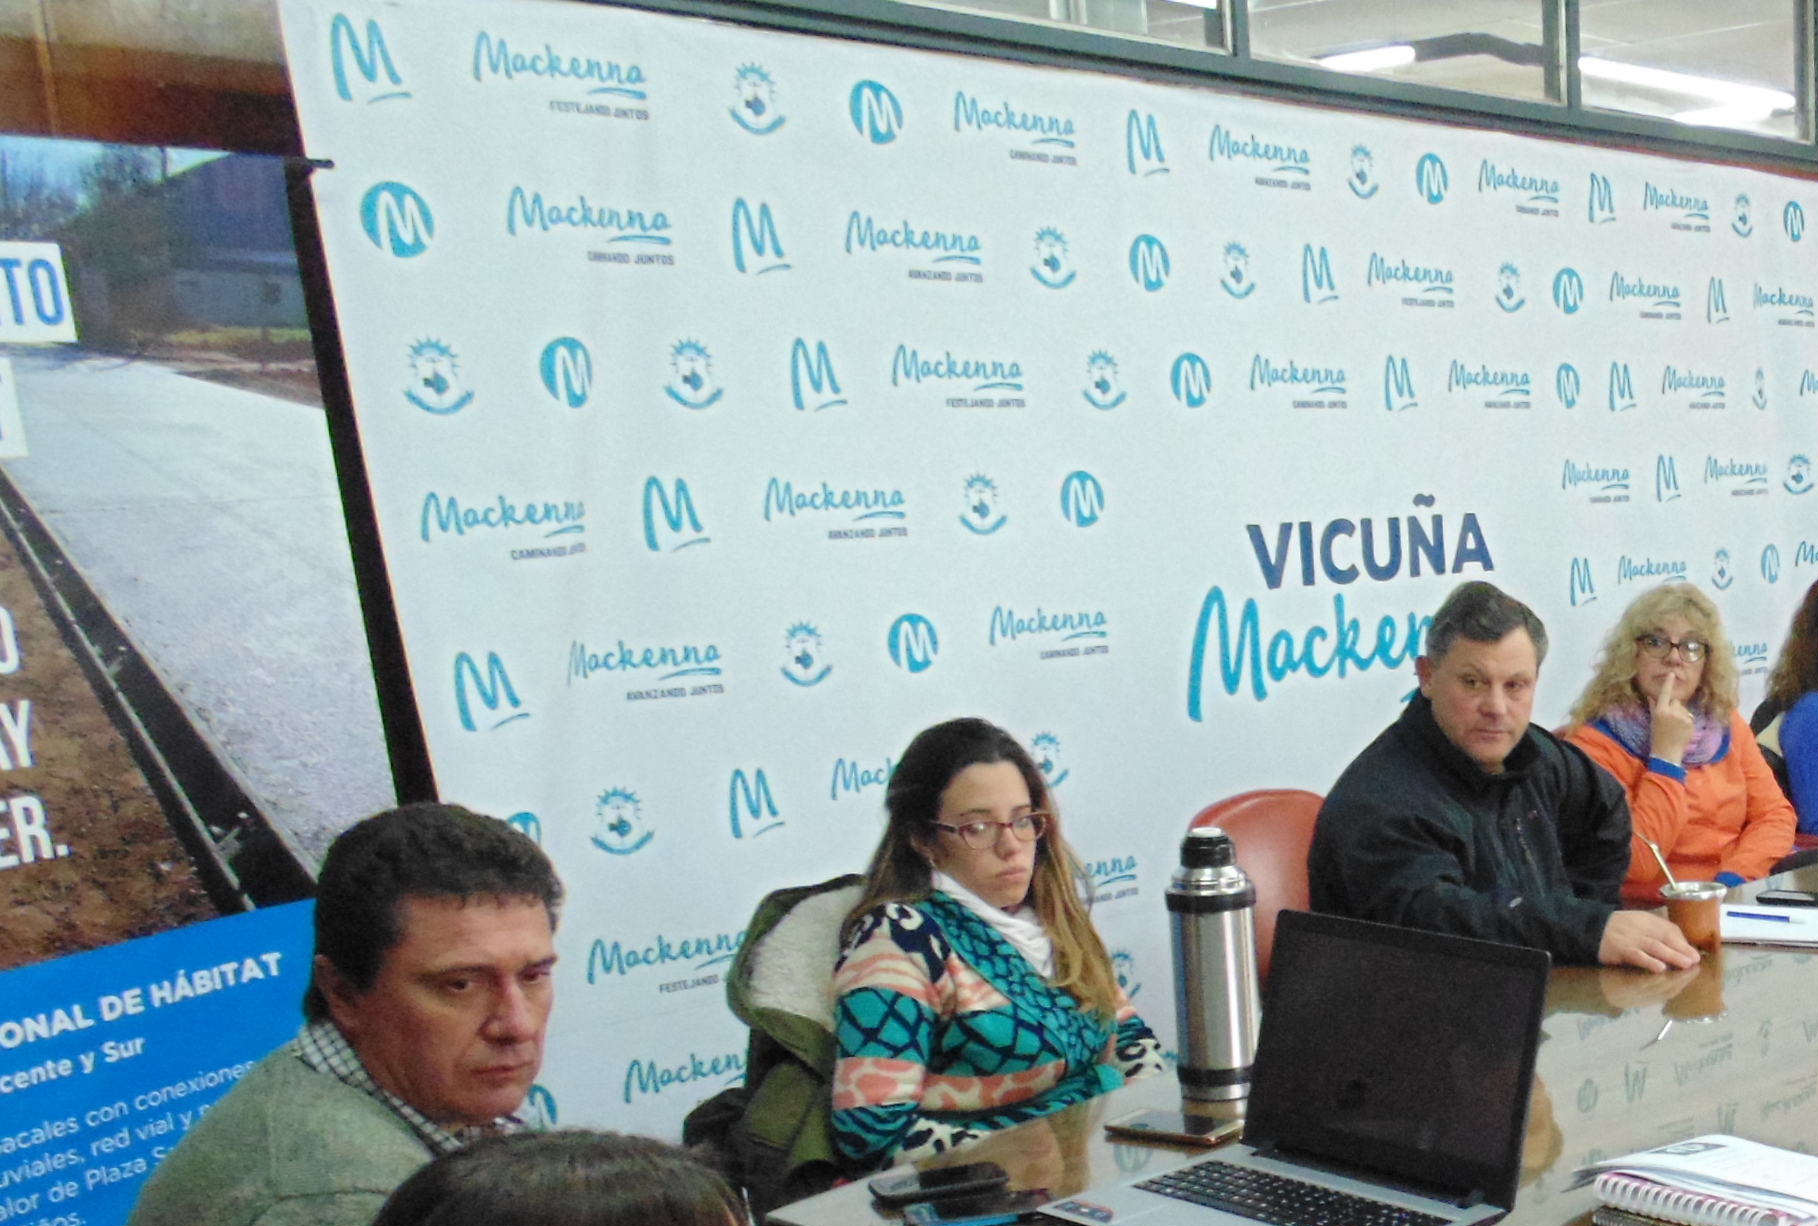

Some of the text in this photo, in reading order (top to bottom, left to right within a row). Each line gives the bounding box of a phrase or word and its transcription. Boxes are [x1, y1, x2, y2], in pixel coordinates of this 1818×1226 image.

[473, 32, 647, 86] Mackenna
[954, 91, 1075, 136] Mackenna
[1208, 124, 1309, 167] Mackenna
[1479, 159, 1559, 194] Mackenna
[1644, 181, 1709, 212] Mackenna
[507, 186, 671, 237] Mackenna
[845, 211, 982, 253] Mackenna
[634, 253, 674, 267] JUNTOS
[1367, 252, 1453, 288] Mackenna
[1609, 271, 1680, 302] Mackenna
[892, 345, 1023, 387] Mackenna
[1250, 354, 1345, 392] Mackenna
[1449, 359, 1530, 393] Mackenna
[1662, 365, 1725, 395] Mackenna
[1563, 458, 1630, 490] Mackenna
[1704, 456, 1767, 484] Mackenna
[764, 478, 905, 521] Mackenna
[1246, 493, 1494, 589] VICUÑA
[1618, 555, 1687, 584] Mackenna
[989, 606, 1107, 645] Mackenna
[567, 640, 722, 687] Mackenna
[1187, 585, 1433, 722] Macken
[626, 684, 725, 702] AVANZANDO JUNTOS
[830, 757, 896, 800] Mack
[0, 952, 283, 1048] ONAL DE HÁBITAT
[659, 974, 719, 994] FESTEJANDO
[0, 1037, 145, 1093] cente y Sur
[624, 1050, 746, 1104] Macken
[0, 1117, 79, 1154] acales
[85, 1101, 129, 1127] con
[90, 1128, 131, 1156] red
[135, 1112, 175, 1140] vial
[179, 1110, 193, 1131] y
[48, 1180, 79, 1203] de
[85, 1158, 147, 1191] Plaza
